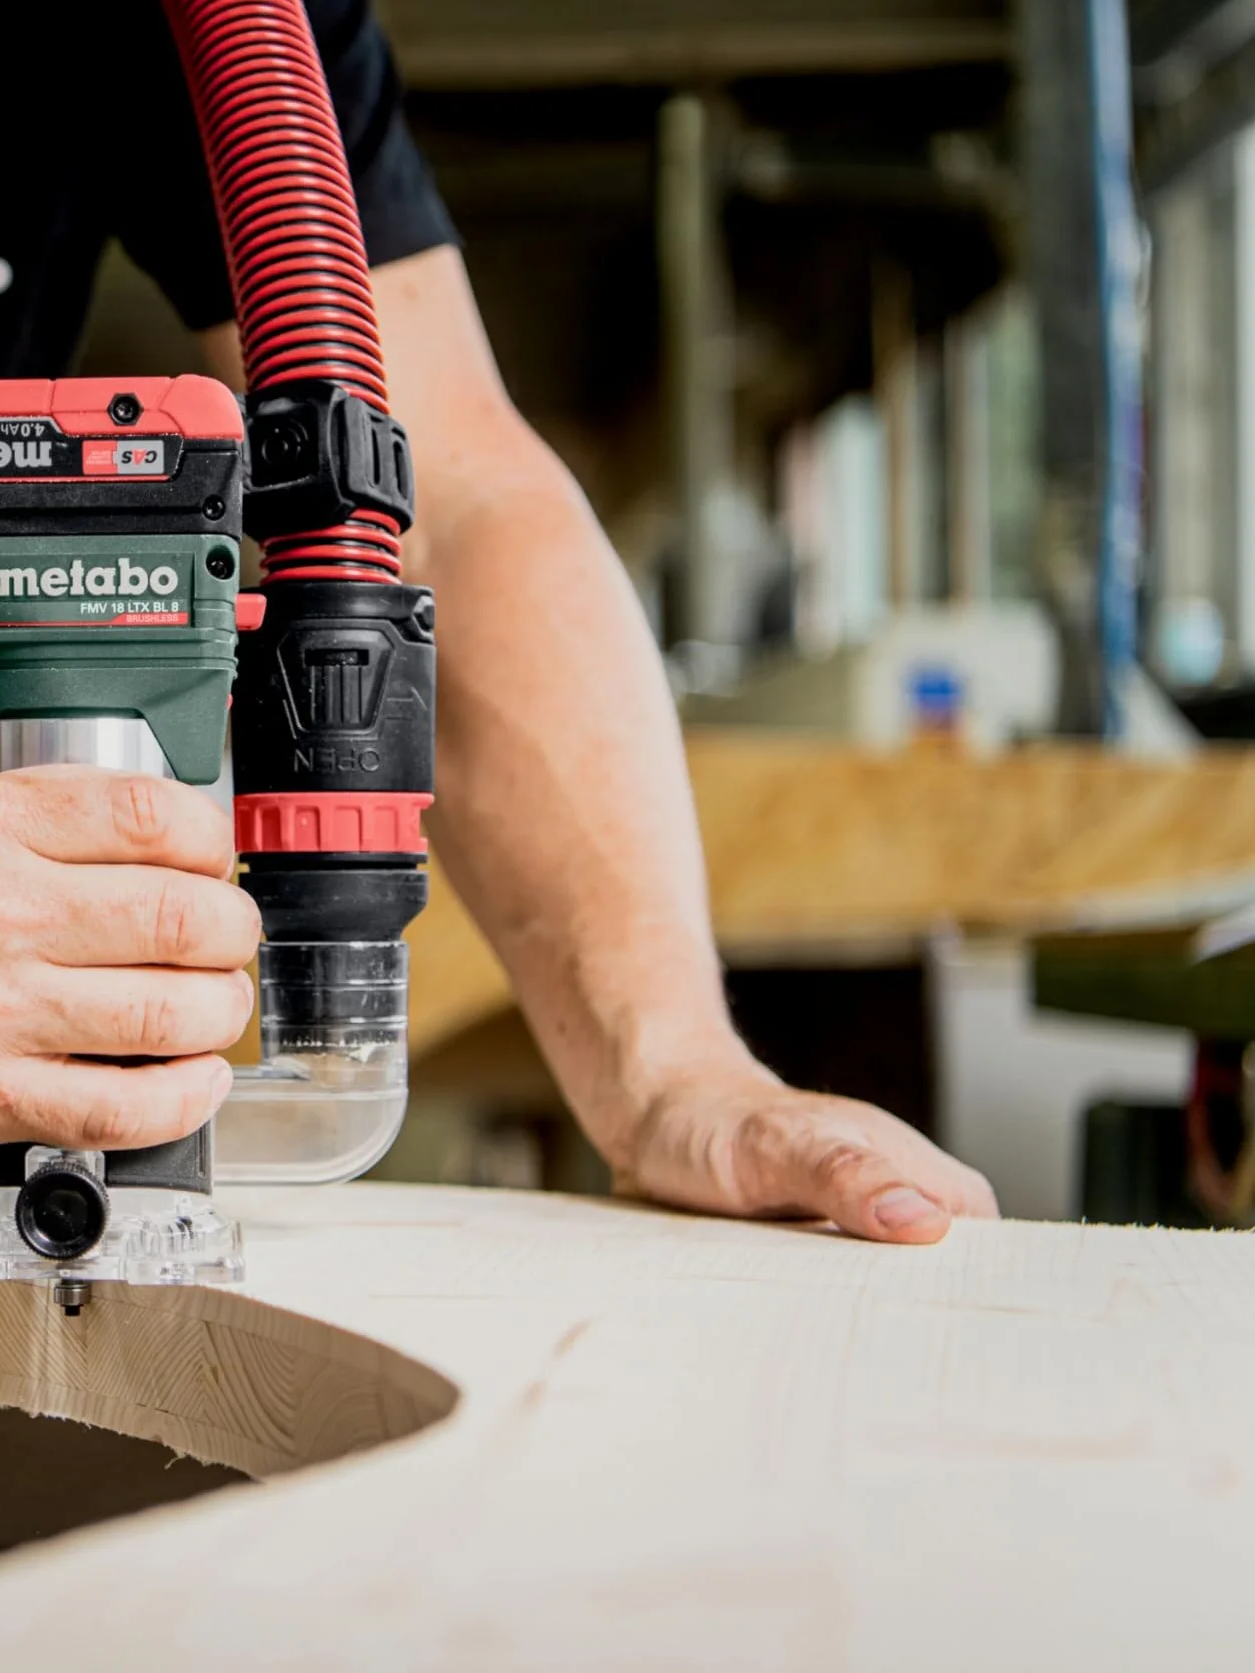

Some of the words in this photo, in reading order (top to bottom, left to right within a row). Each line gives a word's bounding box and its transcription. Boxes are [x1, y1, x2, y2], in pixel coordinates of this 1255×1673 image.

[0, 424, 45, 437] 4.0Ah
[121, 445, 158, 465] CAS
[80, 602, 107, 614] FMV
[111, 602, 125, 614] 18
[127, 602, 149, 614] LTX
[153, 602, 169, 613] BL
[171, 602, 179, 613] 8
[126, 614, 178, 623] BRUSHLESS
